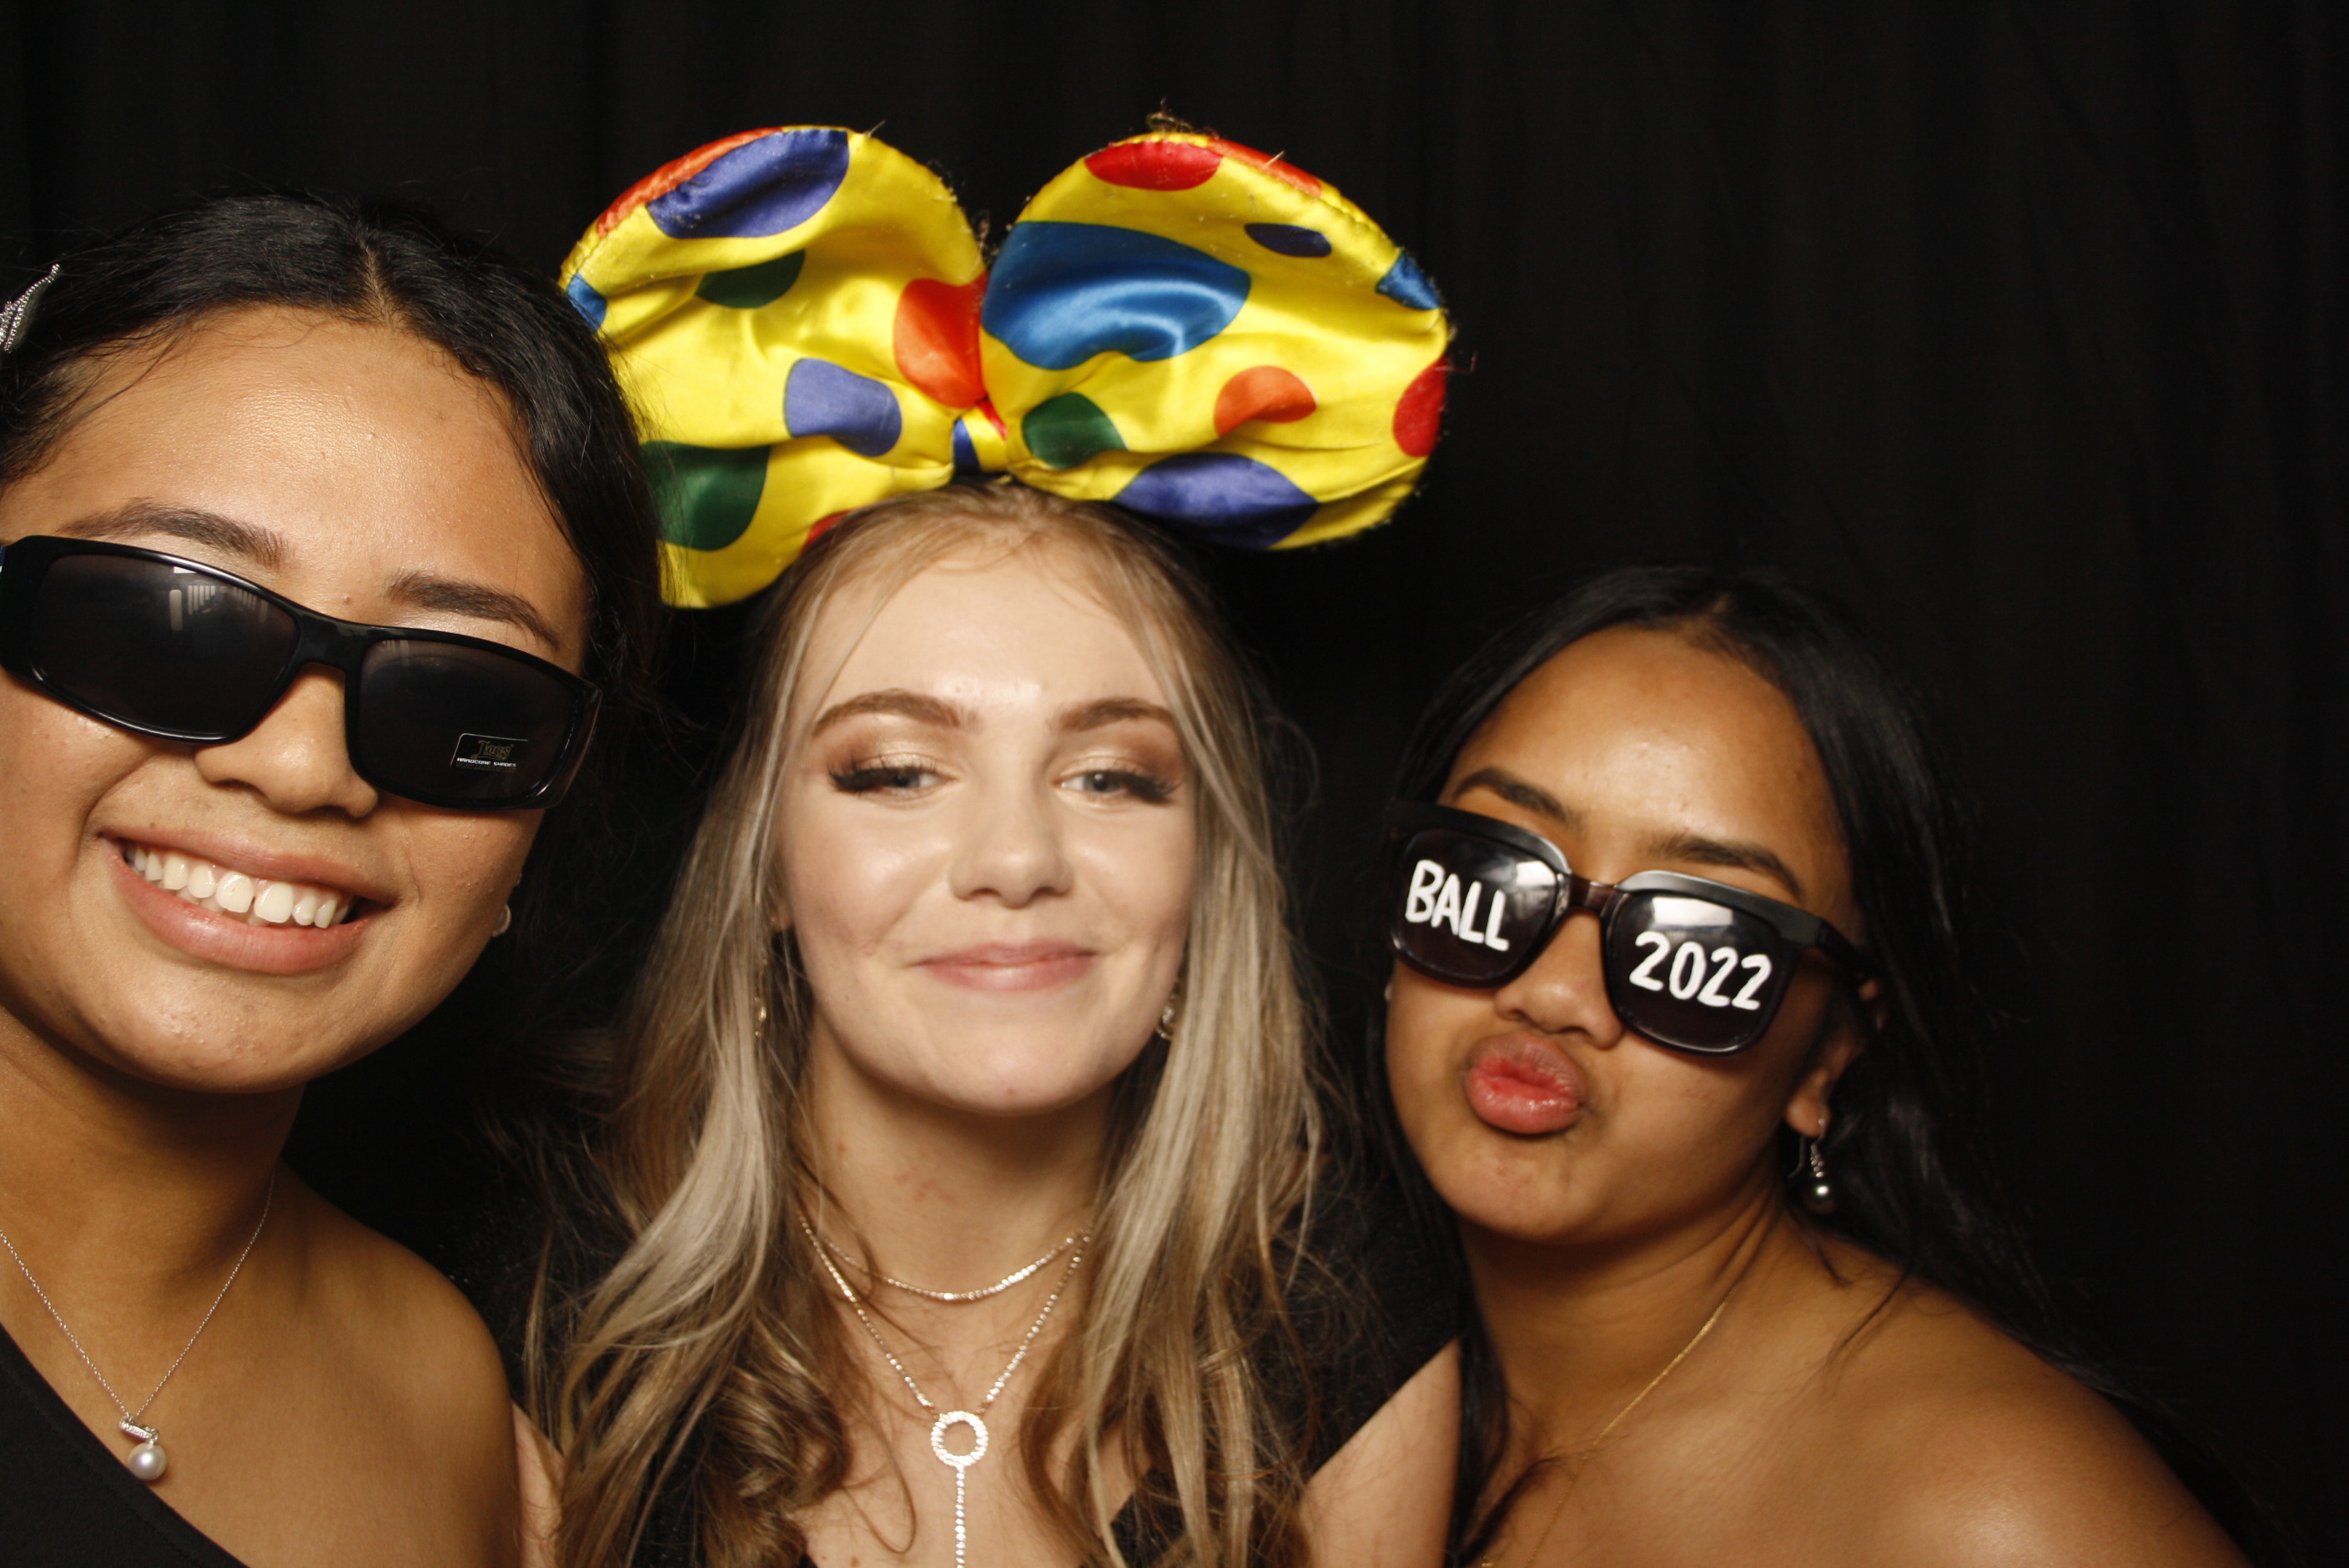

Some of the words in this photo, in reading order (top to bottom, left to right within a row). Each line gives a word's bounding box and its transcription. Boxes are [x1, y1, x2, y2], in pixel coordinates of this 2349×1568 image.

[456, 757, 491, 766] HARDCORE
[1405, 859, 1510, 952] BALL
[1629, 931, 1772, 1010] 2022
